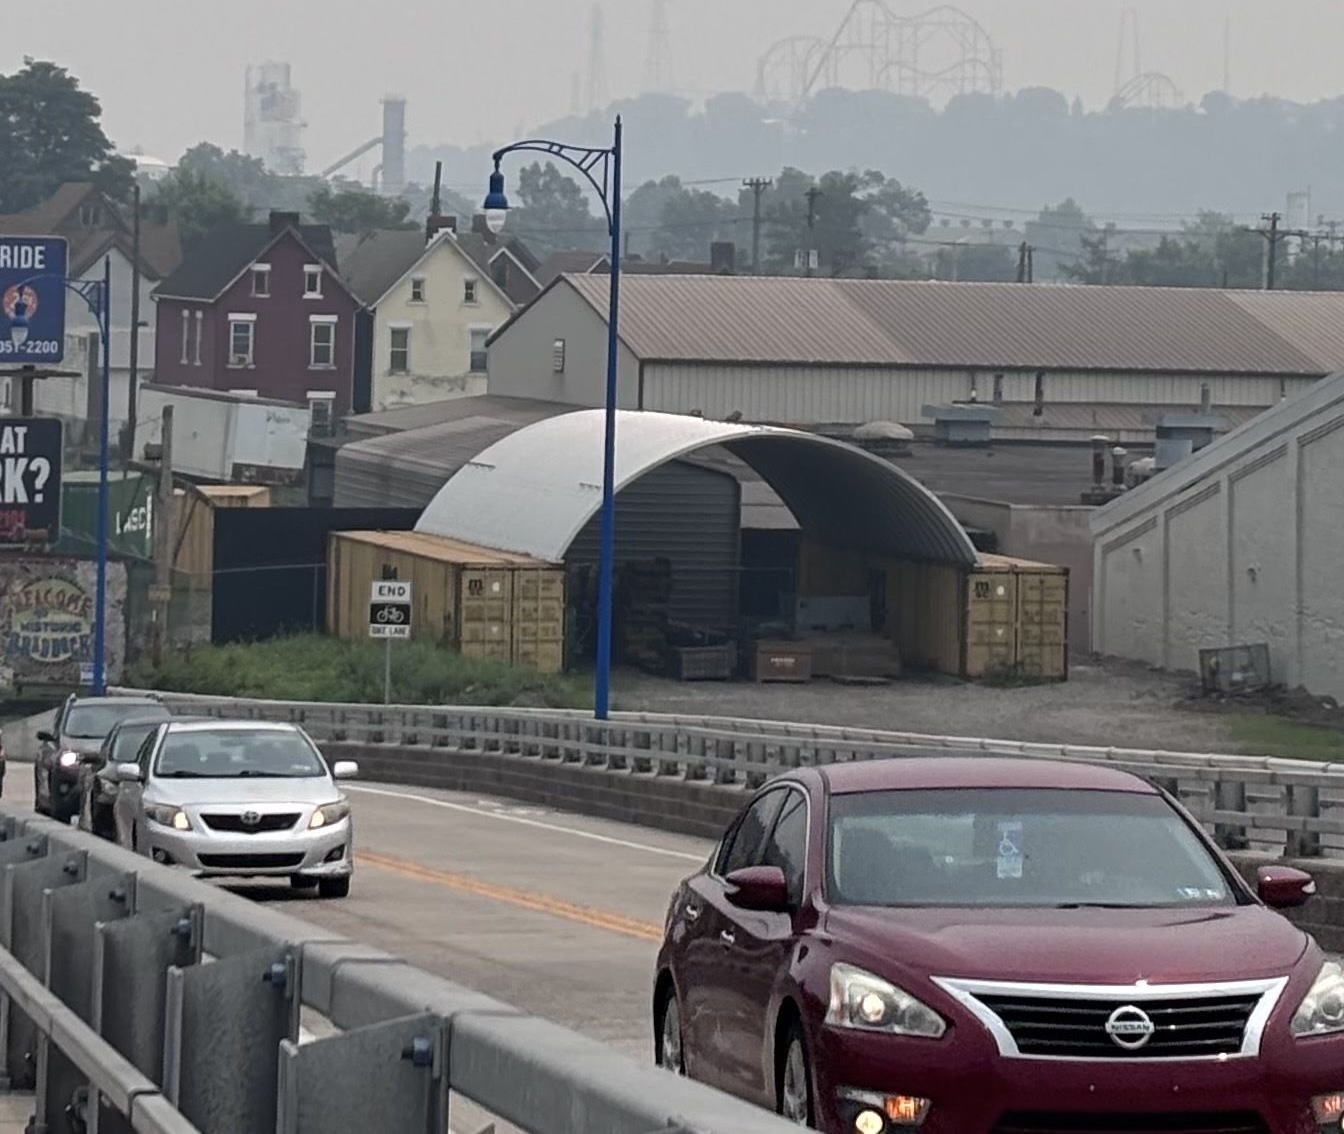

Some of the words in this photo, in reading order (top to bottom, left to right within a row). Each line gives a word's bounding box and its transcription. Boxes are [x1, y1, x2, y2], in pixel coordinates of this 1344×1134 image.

[0, 246, 46, 269] RIDE
[0, 426, 28, 454] AT
[378, 585, 406, 596] END
